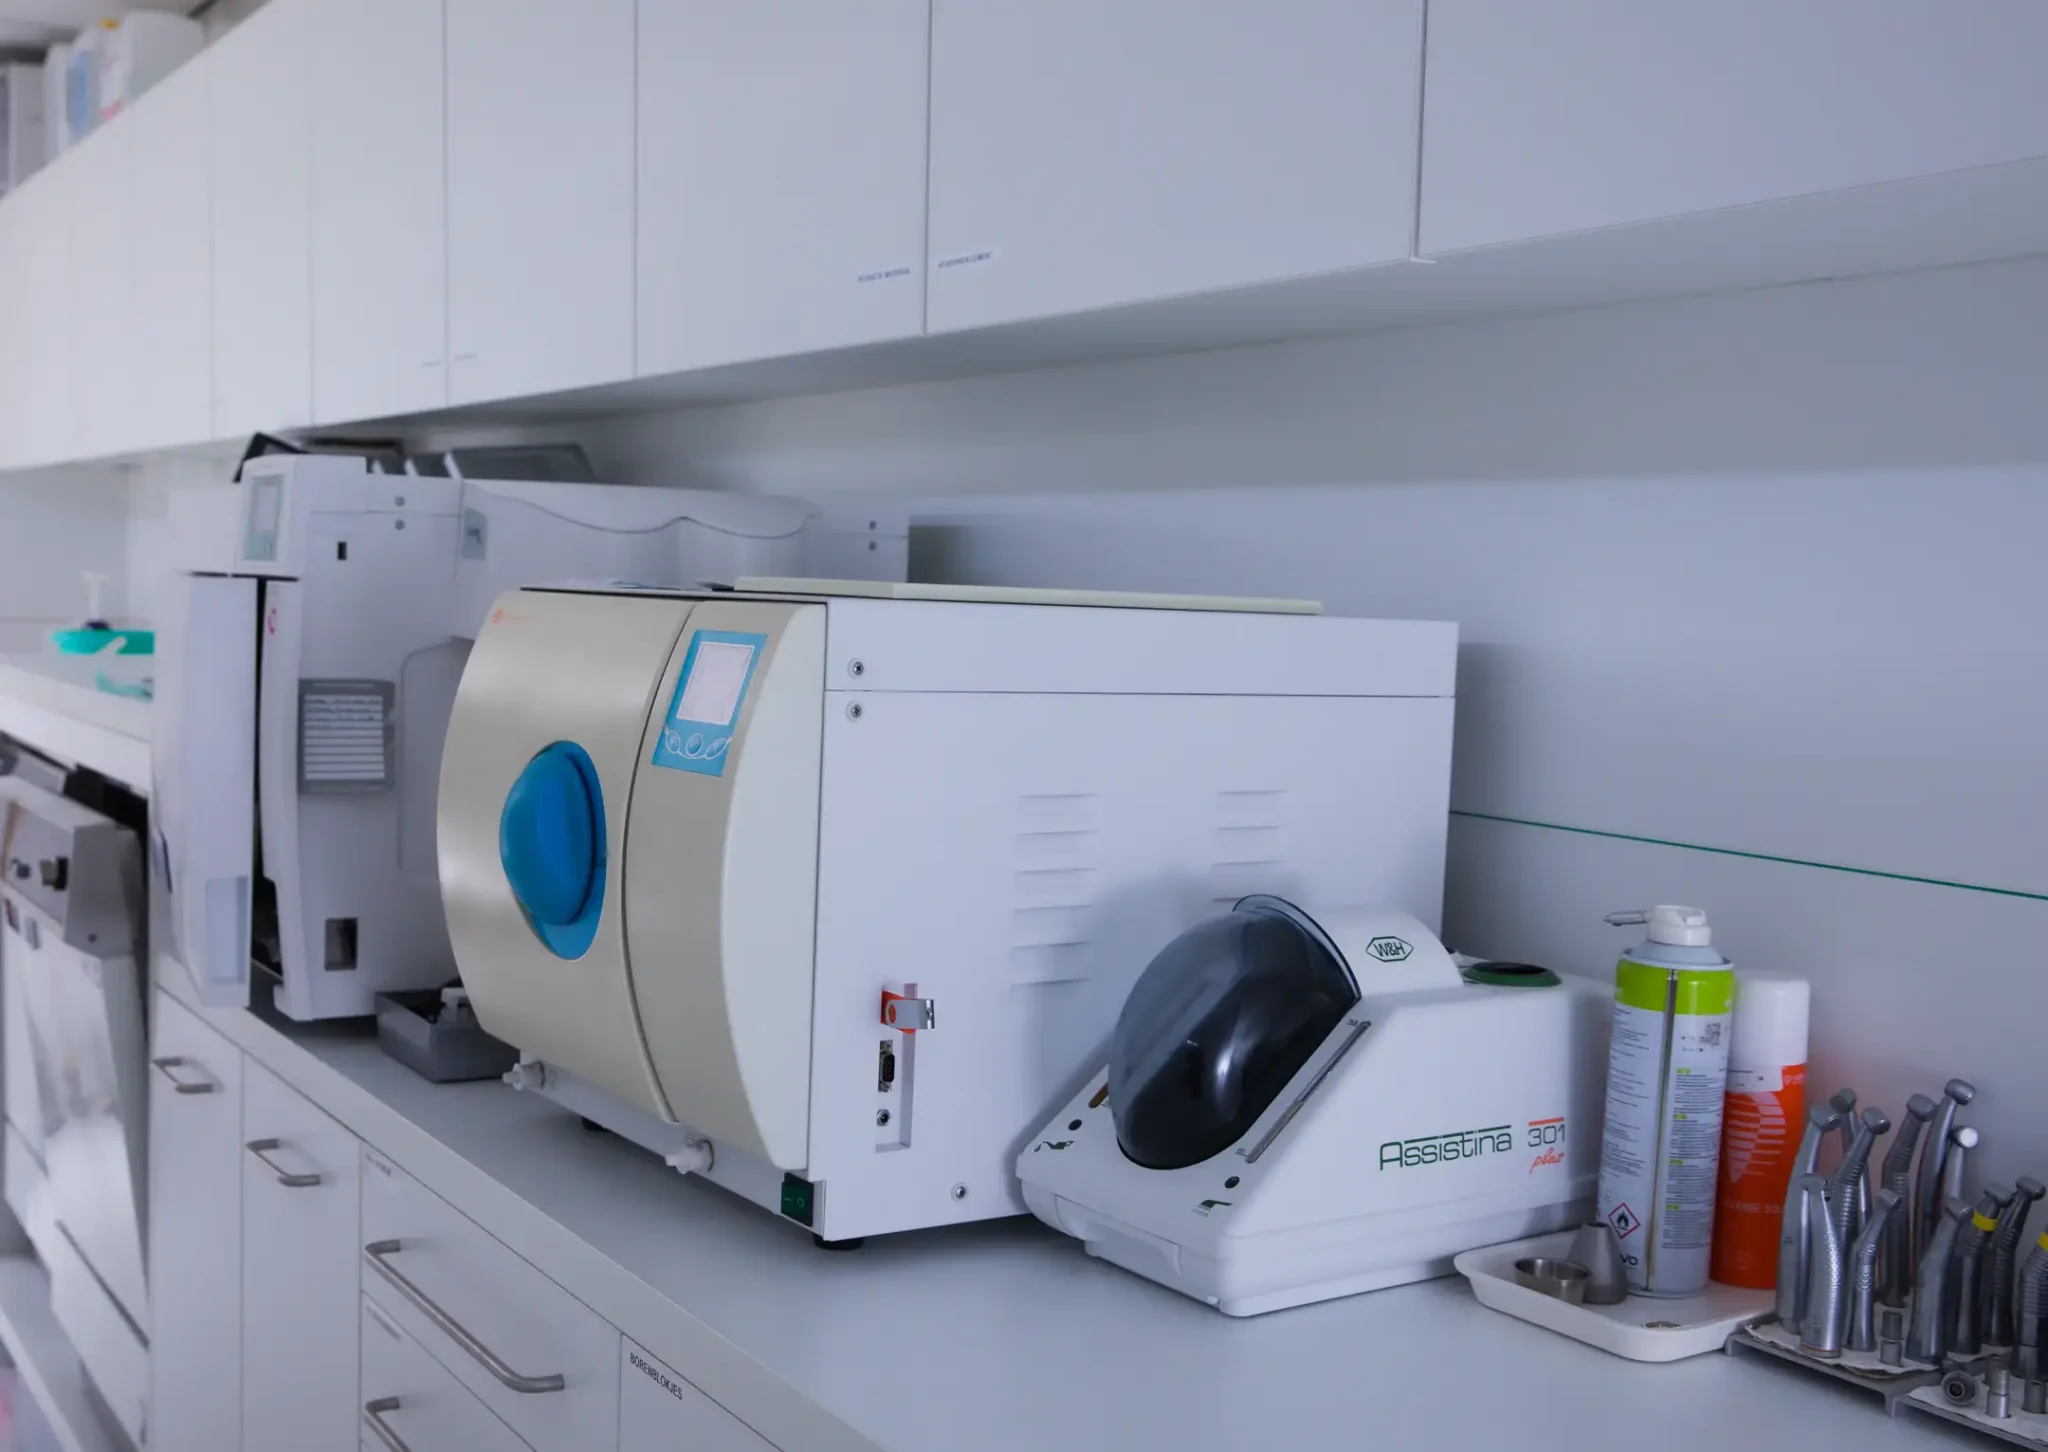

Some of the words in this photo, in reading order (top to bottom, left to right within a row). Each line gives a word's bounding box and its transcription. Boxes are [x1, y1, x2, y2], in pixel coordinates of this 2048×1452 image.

[1373, 942, 1406, 957] W&H
[1379, 1126, 1512, 1171] Assistina
[1527, 1121, 1566, 1148] 301
[1528, 1147, 1566, 1174] plus
[629, 1352, 683, 1400] BORENBLOKJES
